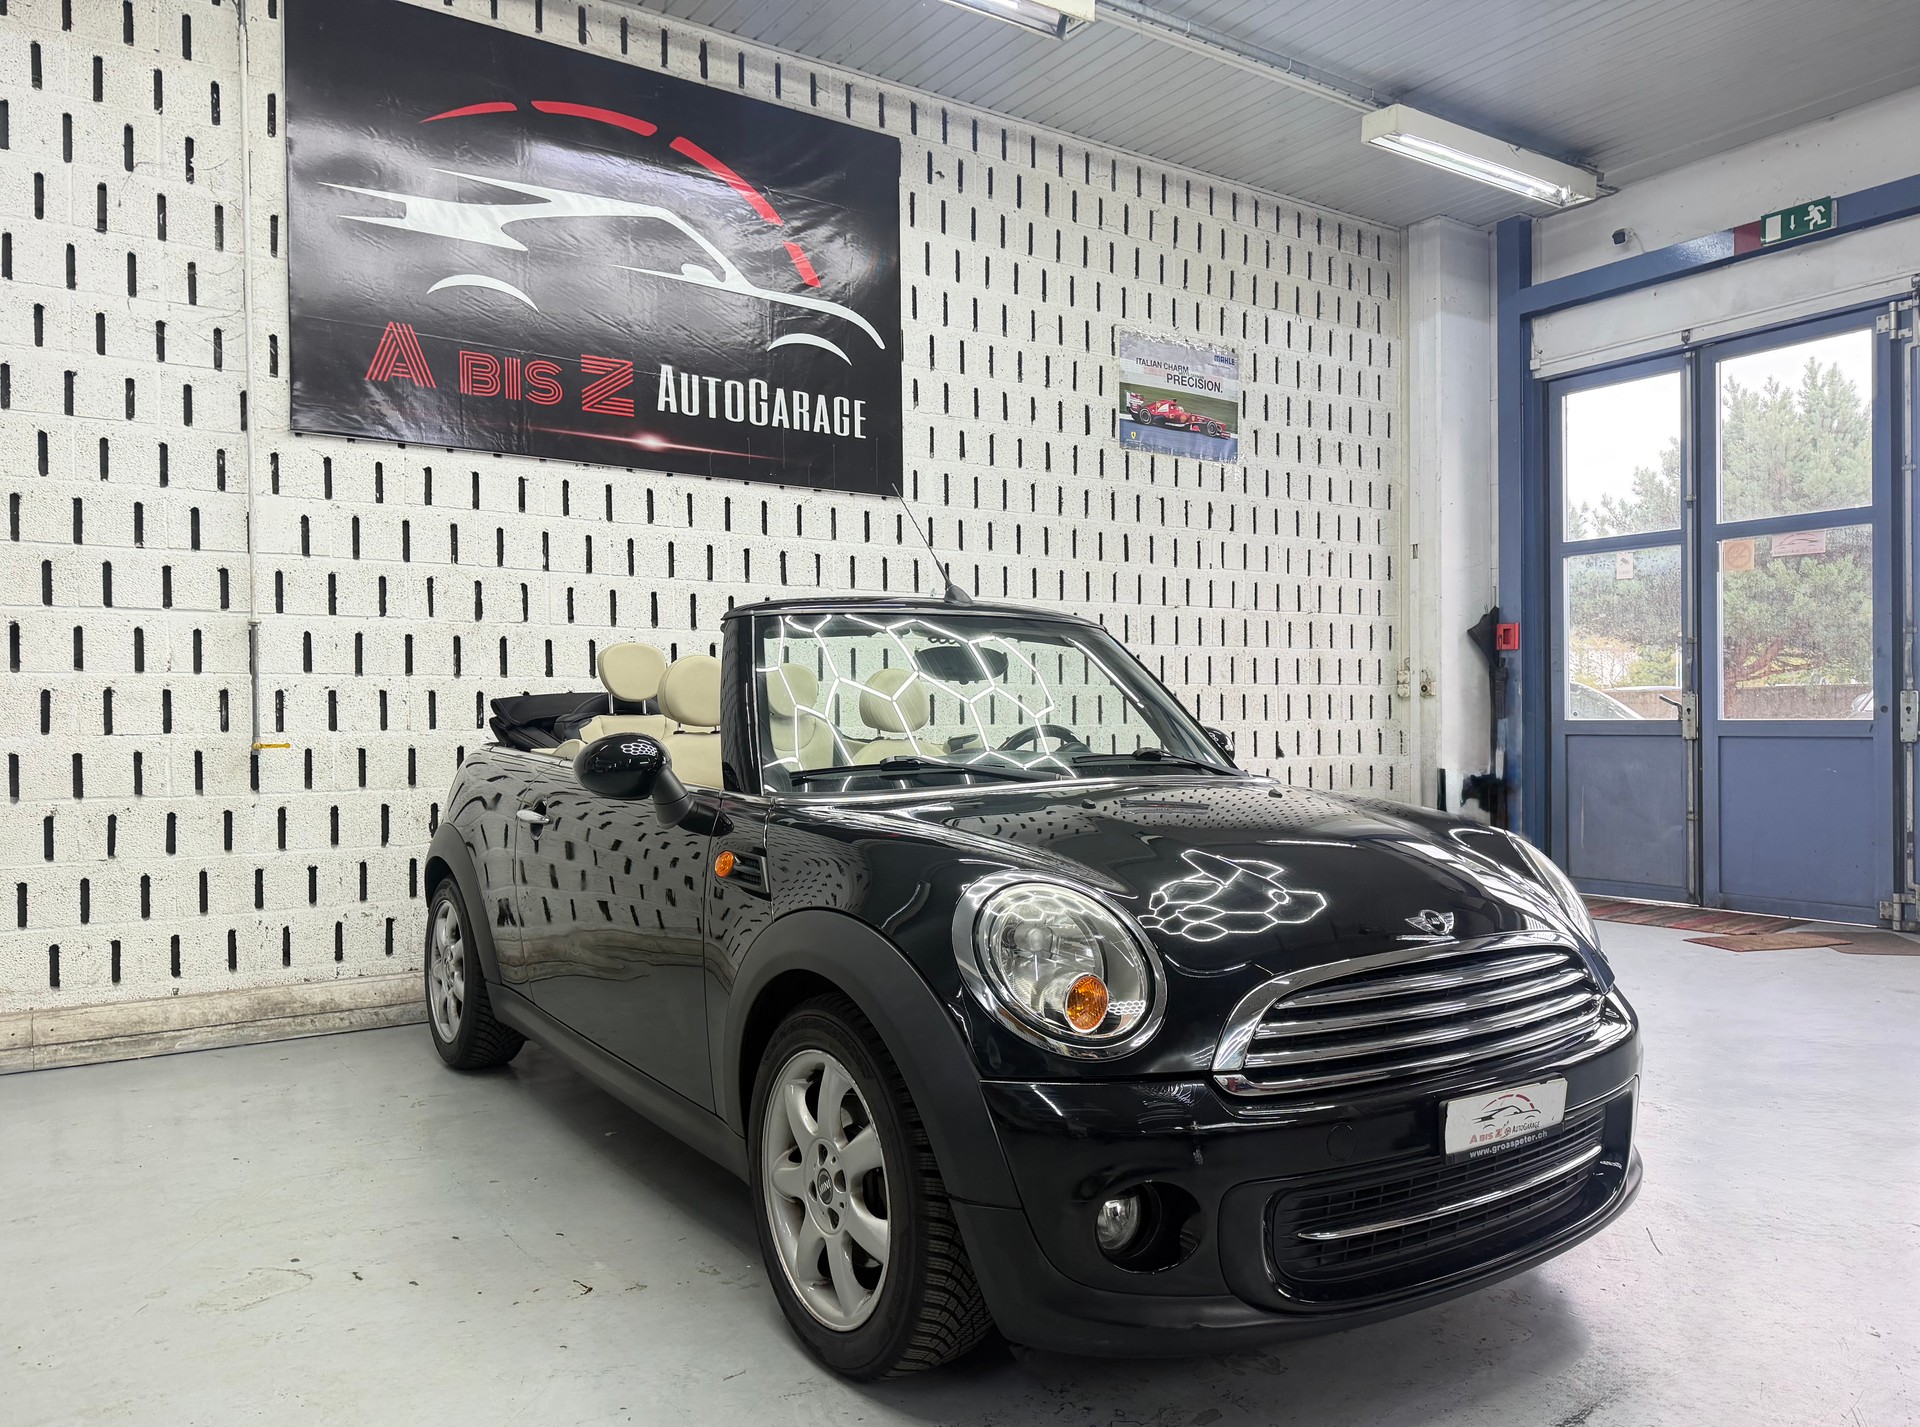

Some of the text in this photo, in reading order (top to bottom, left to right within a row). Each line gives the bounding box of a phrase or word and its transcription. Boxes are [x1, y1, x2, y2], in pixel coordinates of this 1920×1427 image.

[365, 321, 436, 388] A
[459, 350, 563, 405] BIS
[581, 354, 634, 417] Z
[1136, 357, 1189, 373] ITALIAN CHARM
[1166, 373, 1223, 393] PRECISION.
[1469, 1134, 1478, 1144] A
[1469, 1130, 1548, 1158] www.grosspeter.ch
